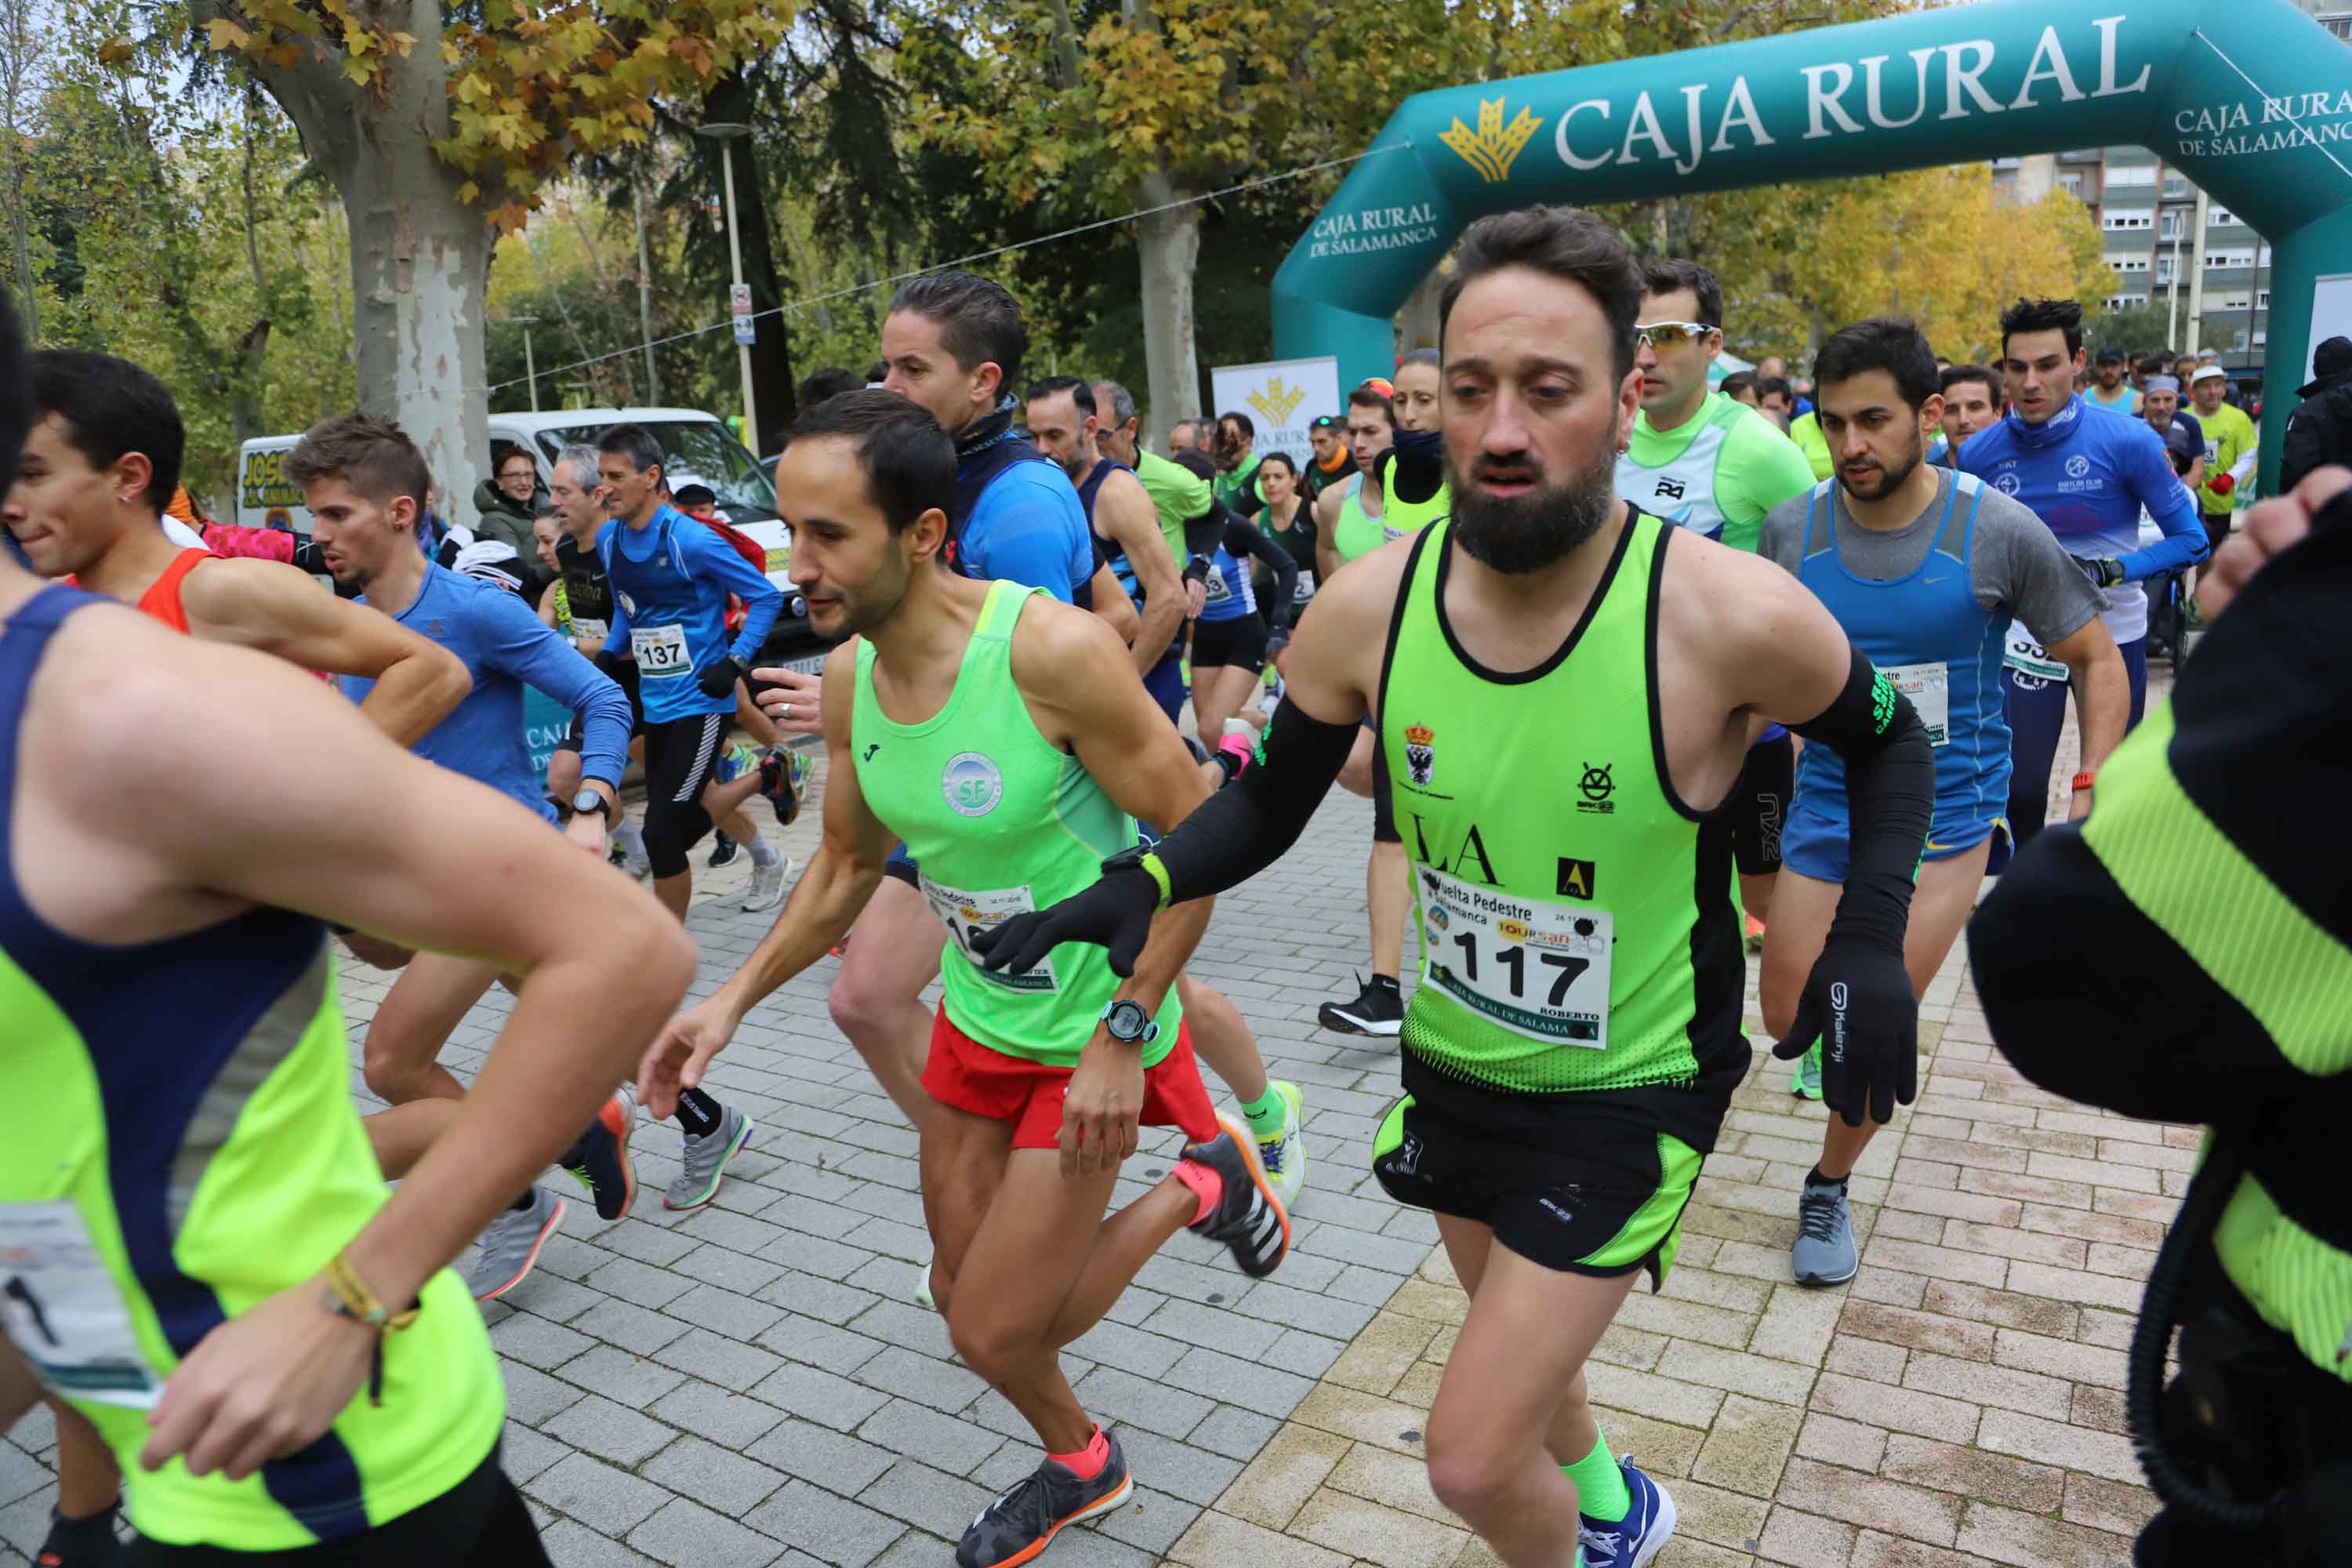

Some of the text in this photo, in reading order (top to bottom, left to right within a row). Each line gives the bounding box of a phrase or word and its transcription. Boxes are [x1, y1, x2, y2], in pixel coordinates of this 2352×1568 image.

[1555, 14, 2151, 176] CAJA RURAL
[2175, 102, 2251, 137] CAJA
[2179, 140, 2206, 156] DE
[1313, 202, 1437, 239] CAJA RURAL
[1310, 227, 1438, 258] DE SALAMANCA
[643, 643, 681, 666] 137
[1473, 891, 1533, 922] Pedestre
[1454, 931, 1590, 1007] 117
[1467, 992, 1501, 1019] RURAL
[1518, 1014, 1596, 1037] SALAMAA
[1539, 1007, 1600, 1021] ROBERTO
